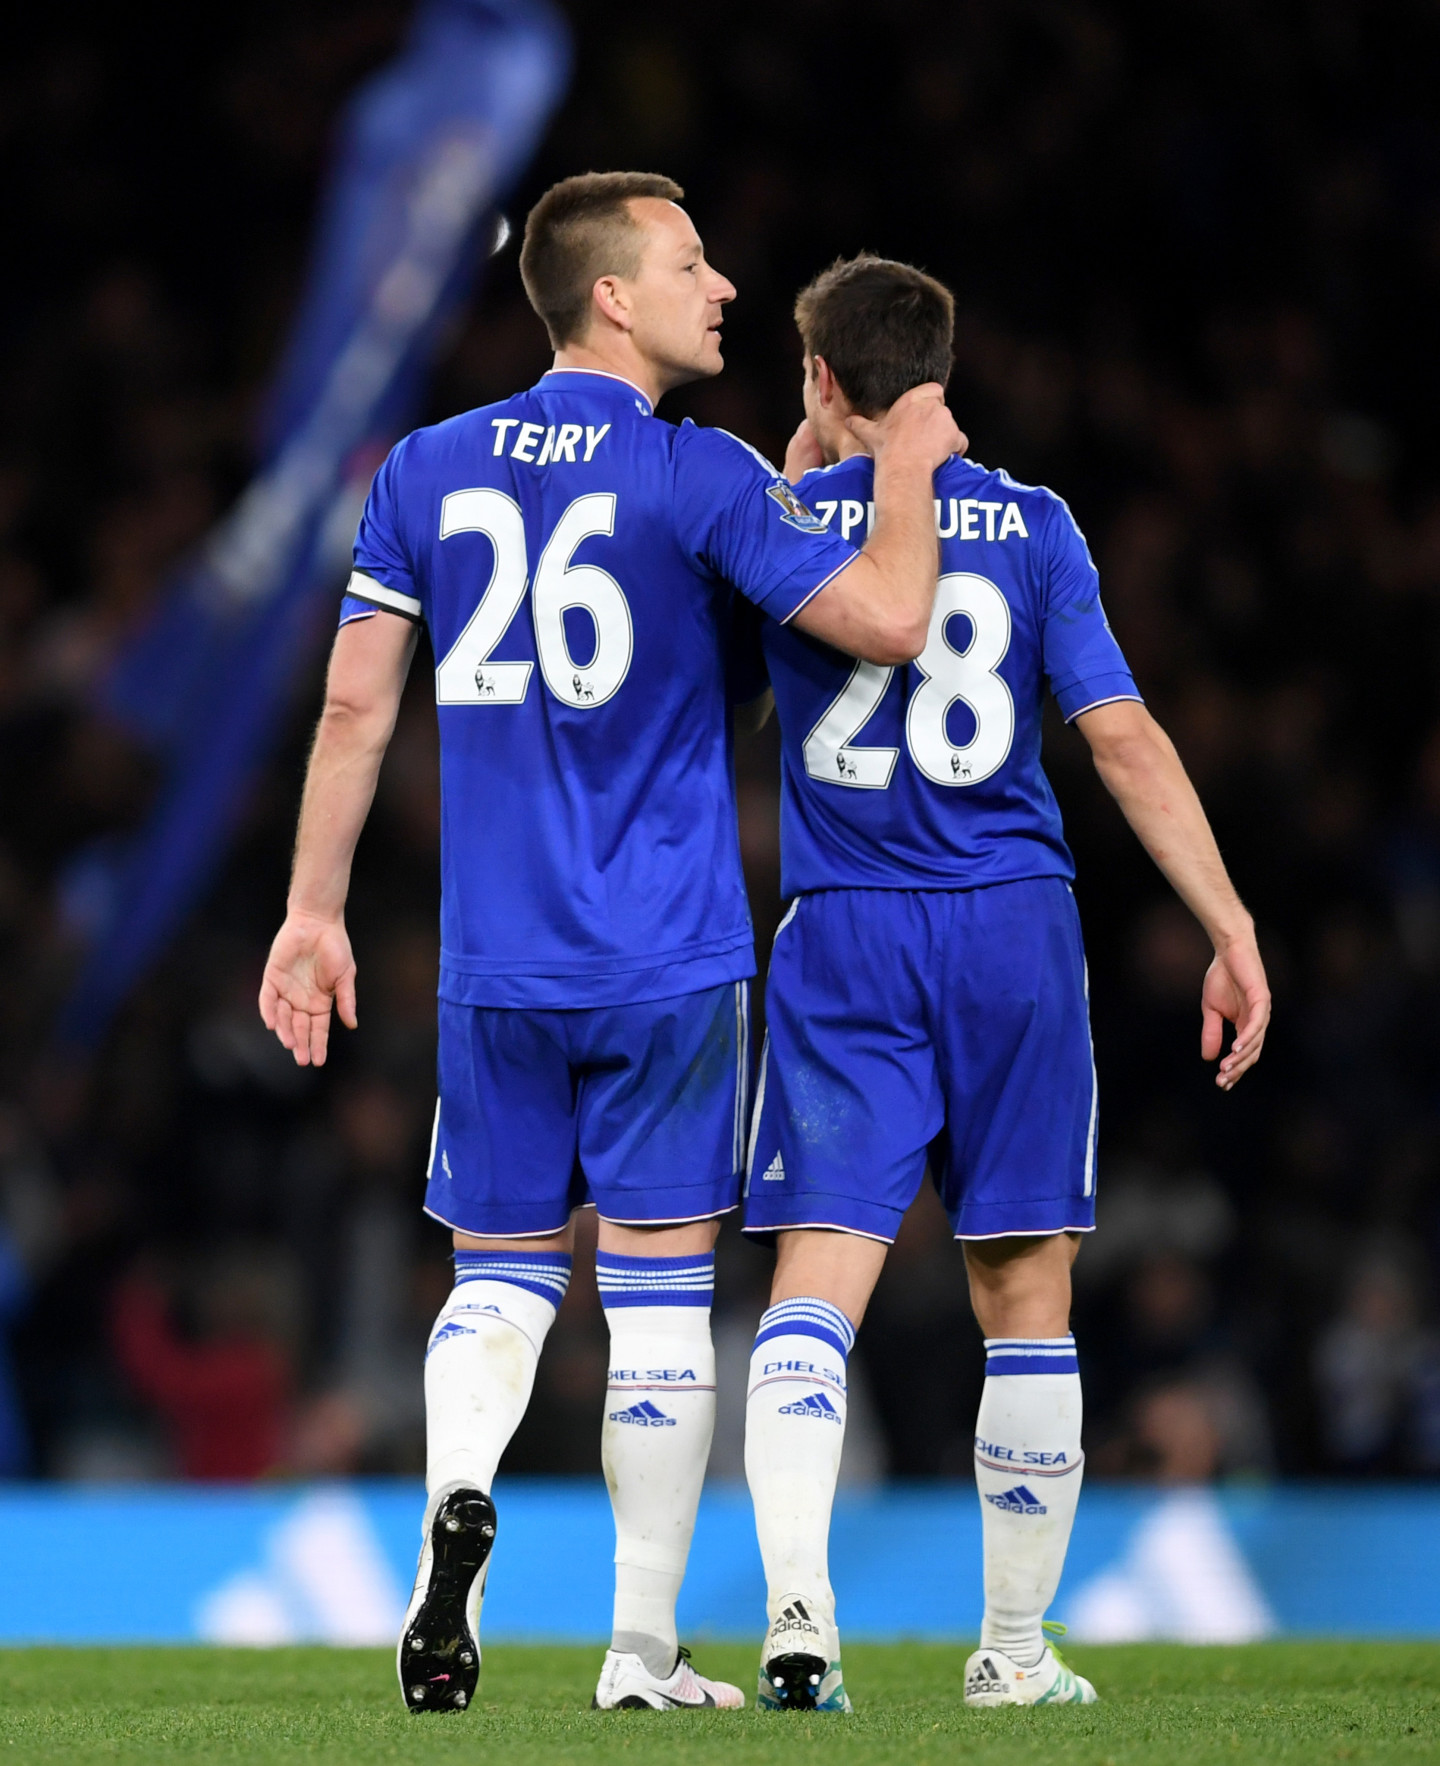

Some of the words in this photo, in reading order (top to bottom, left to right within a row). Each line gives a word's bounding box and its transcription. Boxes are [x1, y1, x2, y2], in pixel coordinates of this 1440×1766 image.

[435, 487, 634, 709] 26
[763, 1360, 848, 1392] CHELSE
[608, 1411, 677, 1427] adidas
[777, 1404, 842, 1425] adidas
[974, 1436, 1068, 1466] CHELSEA
[771, 1618, 820, 1638] adidas
